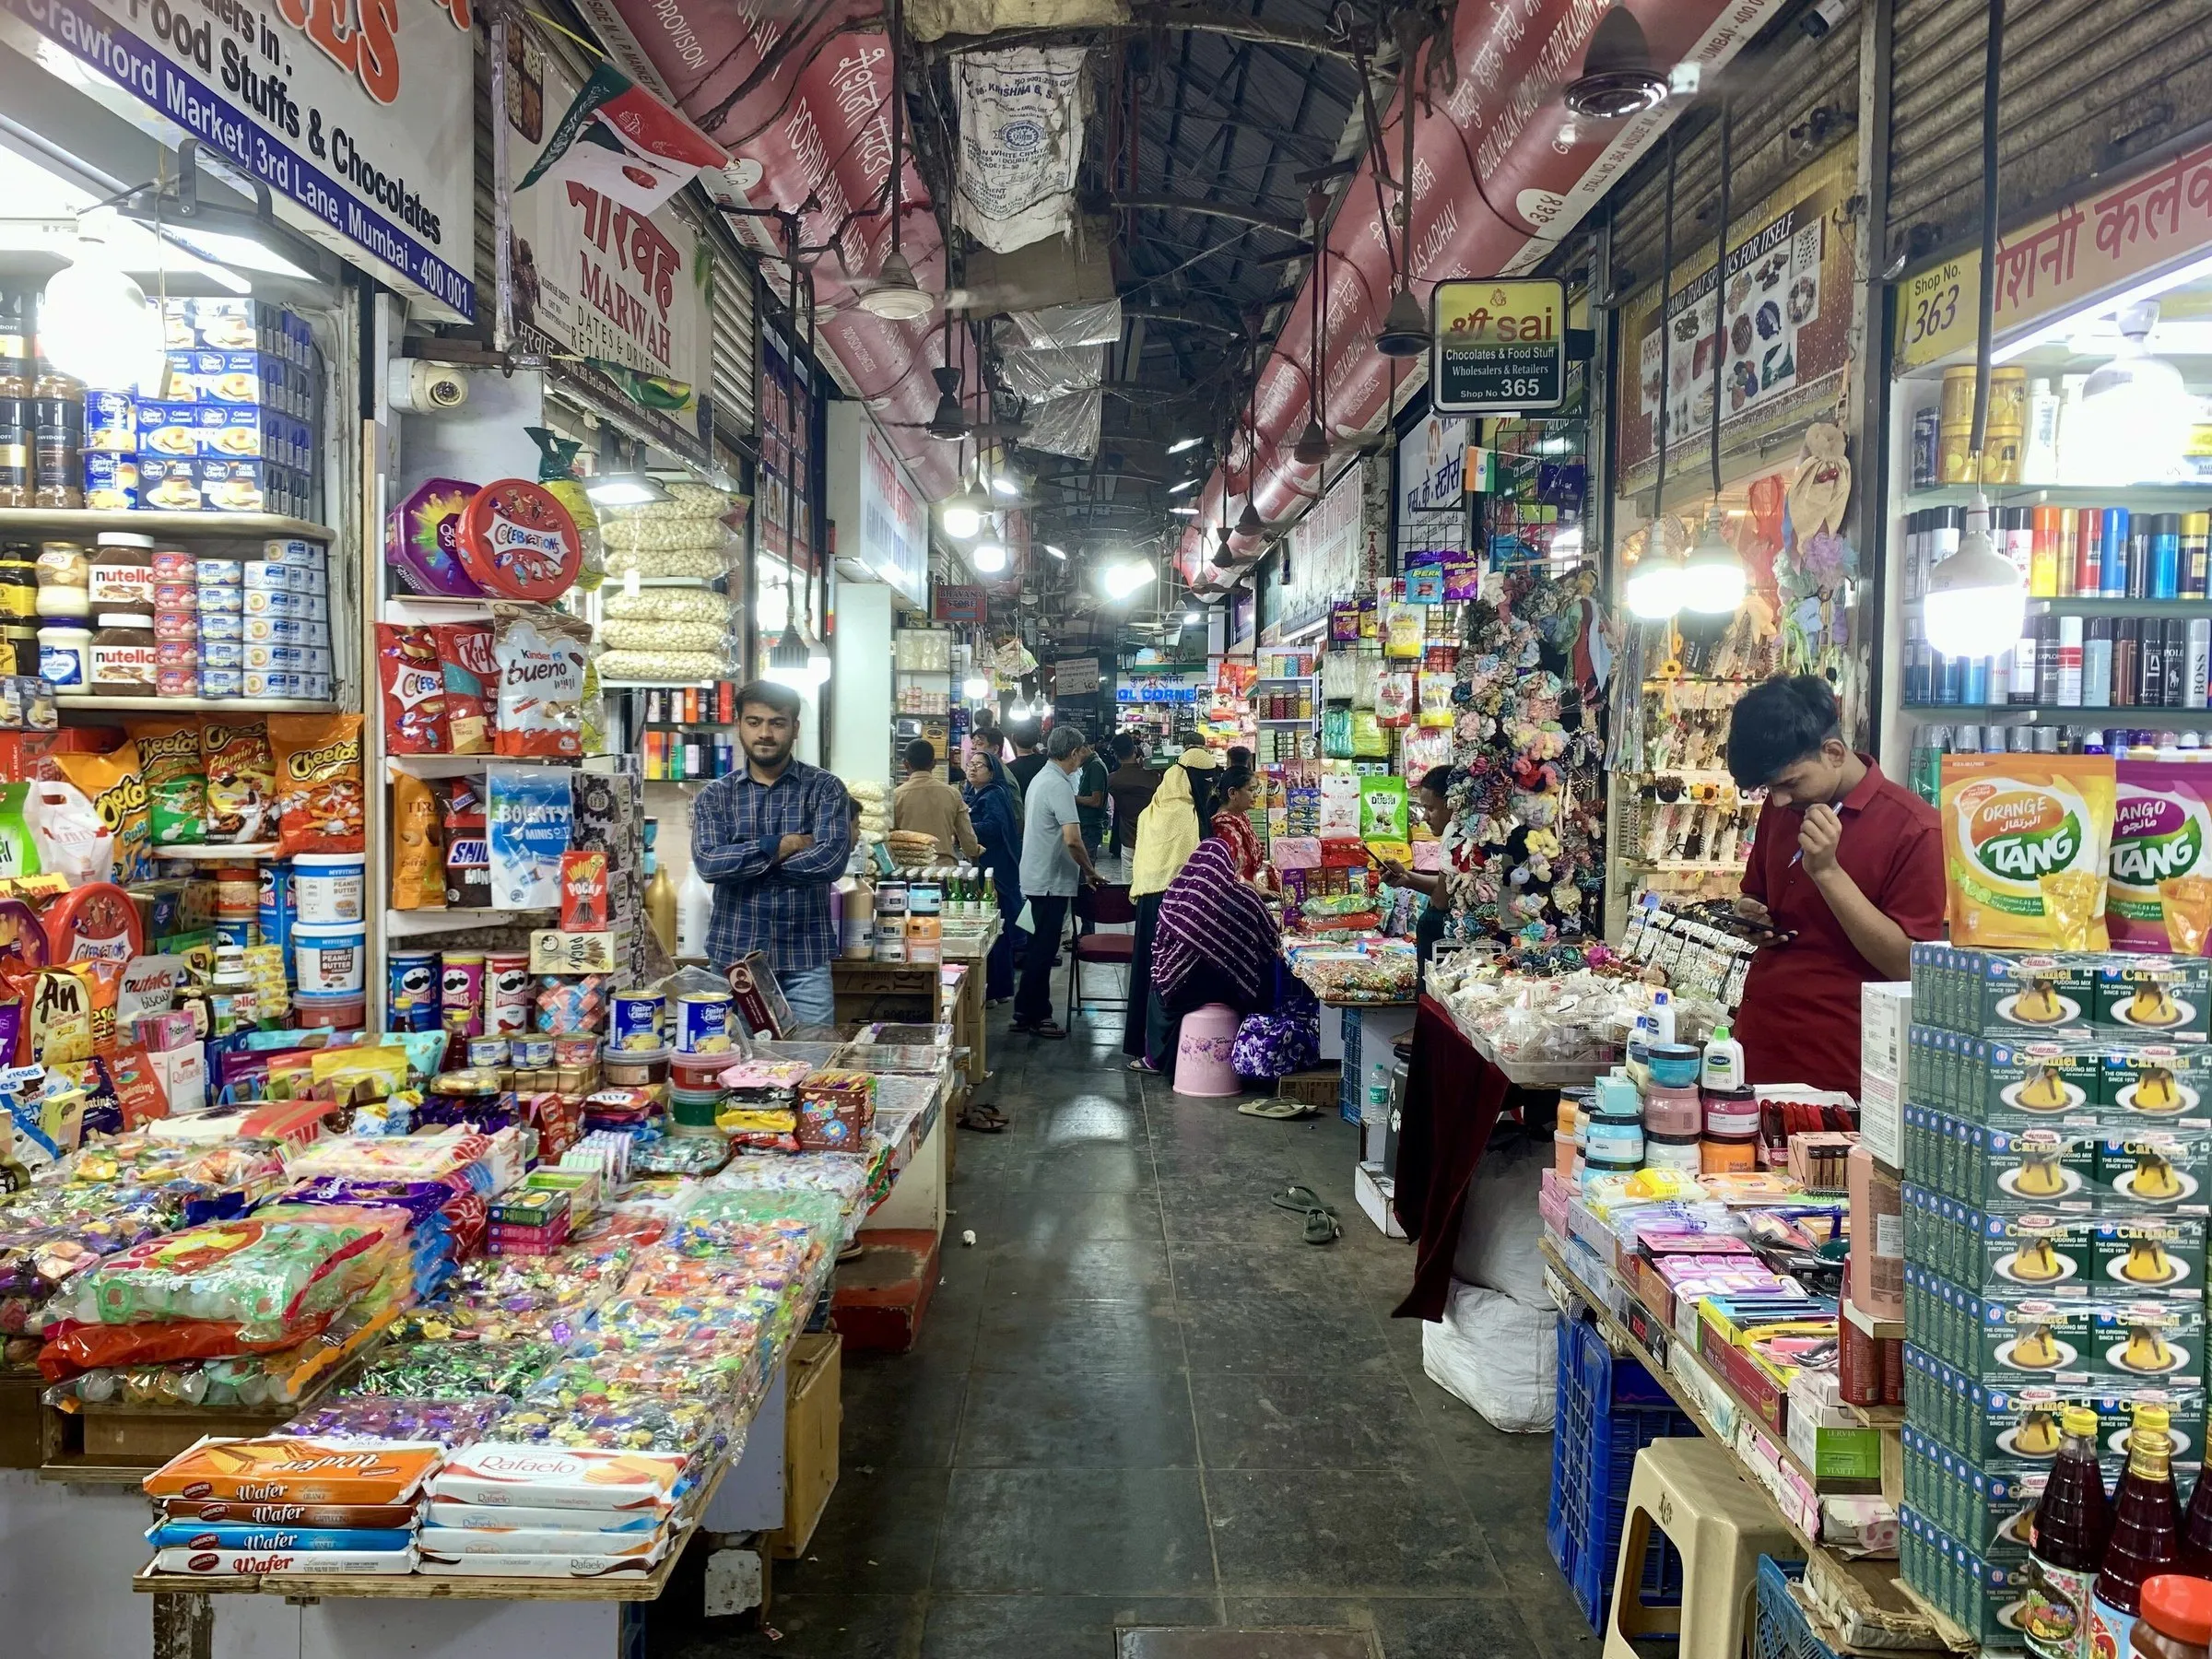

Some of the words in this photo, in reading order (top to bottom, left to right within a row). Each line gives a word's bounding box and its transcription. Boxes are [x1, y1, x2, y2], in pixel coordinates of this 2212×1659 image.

[260, 13, 280, 66] in
[653, 0, 709, 71] PROVISION
[126, 0, 212, 76] ood
[221, 38, 300, 138] Stuffs
[309, 108, 327, 161] &
[332, 127, 441, 246] Chocolates
[1476, 133, 1502, 184] ABDUL
[1492, 100, 1522, 158] RAZAK
[25, 0, 158, 100] Crawford
[166, 70, 250, 170] Market,
[256, 137, 289, 190] 3rd
[295, 163, 343, 232] Lane,
[347, 202, 408, 272] Mumbai
[420, 256, 444, 299] 400
[447, 273, 473, 317] 001.
[784, 95, 830, 191] ROSHNA
[817, 170, 854, 232] PARVE
[1583, 170, 1607, 193] STALL
[1599, 161, 1618, 176] NO.
[1621, 126, 1650, 155] INSIDE
[1424, 198, 1459, 265] JADHAV
[1667, 292, 1687, 319] AND
[1686, 281, 1705, 308] THAT
[1704, 253, 1740, 298] SPKS
[1741, 238, 1759, 266] FOR
[1760, 210, 1795, 256] ITSELF
[1914, 273, 1941, 298] Shop
[1943, 262, 1961, 285] No.
[581, 250, 672, 370] MARWAH
[1912, 283, 1959, 346] 363
[577, 304, 614, 350] DATES
[617, 335, 623, 355] &
[1450, 307, 1494, 340] श्री
[1496, 307, 1552, 343] sai
[1446, 348, 1496, 360] Chocolates
[1499, 348, 1505, 359] &
[1508, 347, 1531, 359] Food
[1533, 347, 1555, 359] Stuff
[1452, 365, 1502, 376] Wholesalers
[1504, 364, 1511, 375] &
[1512, 364, 1548, 375] Retailers
[1461, 390, 1483, 399] Shop
[1486, 389, 1498, 397] No
[1500, 379, 1540, 397] 365
[1411, 569, 1441, 578] PERK
[939, 588, 983, 598] BHAVANA
[947, 599, 977, 608] STORE
[95, 648, 157, 665] nutella
[521, 649, 551, 662] Kinder
[507, 659, 568, 687] bueno
[553, 675, 576, 689] mini
[2194, 653, 2206, 696] BOSS
[1147, 688, 1196, 701] CORNE
[288, 740, 360, 782] Cheetos
[499, 804, 571, 826] BOUNTY
[1983, 795, 2048, 823] ORANGE
[2115, 800, 2167, 823] ANGO
[524, 827, 554, 841] MINIS
[1999, 815, 2042, 833] البرتقال
[1986, 826, 2074, 876] TANG
[2110, 831, 2194, 880] TANG
[328, 867, 362, 876] MYFITNESS
[400, 858, 428, 867] CHEESE
[568, 882, 605, 898] POCKY
[322, 954, 352, 962] PEANUT
[568, 935, 584, 971] POCKY
[322, 961, 352, 970] BUTTER
[629, 1011, 653, 1021] Clarks
[630, 1004, 653, 1013] Foster
[703, 1012, 725, 1022] Clarks
[704, 1004, 725, 1014] Foster
[167, 1023, 192, 1037] Trident
[806, 1109, 835, 1124] POPS
[1827, 1430, 1856, 1438] LERVIA
[273, 1453, 381, 1474] Wafer
[478, 1454, 577, 1475] Rafaelo
[236, 1481, 289, 1501] Wafer
[477, 1492, 511, 1504] Rafaelo
[252, 1504, 305, 1524] Wafer
[462, 1518, 498, 1528] Rafaelo
[243, 1532, 298, 1550] Wafer
[233, 1554, 294, 1575] Wafer
[570, 1558, 606, 1570] Rafaelo
